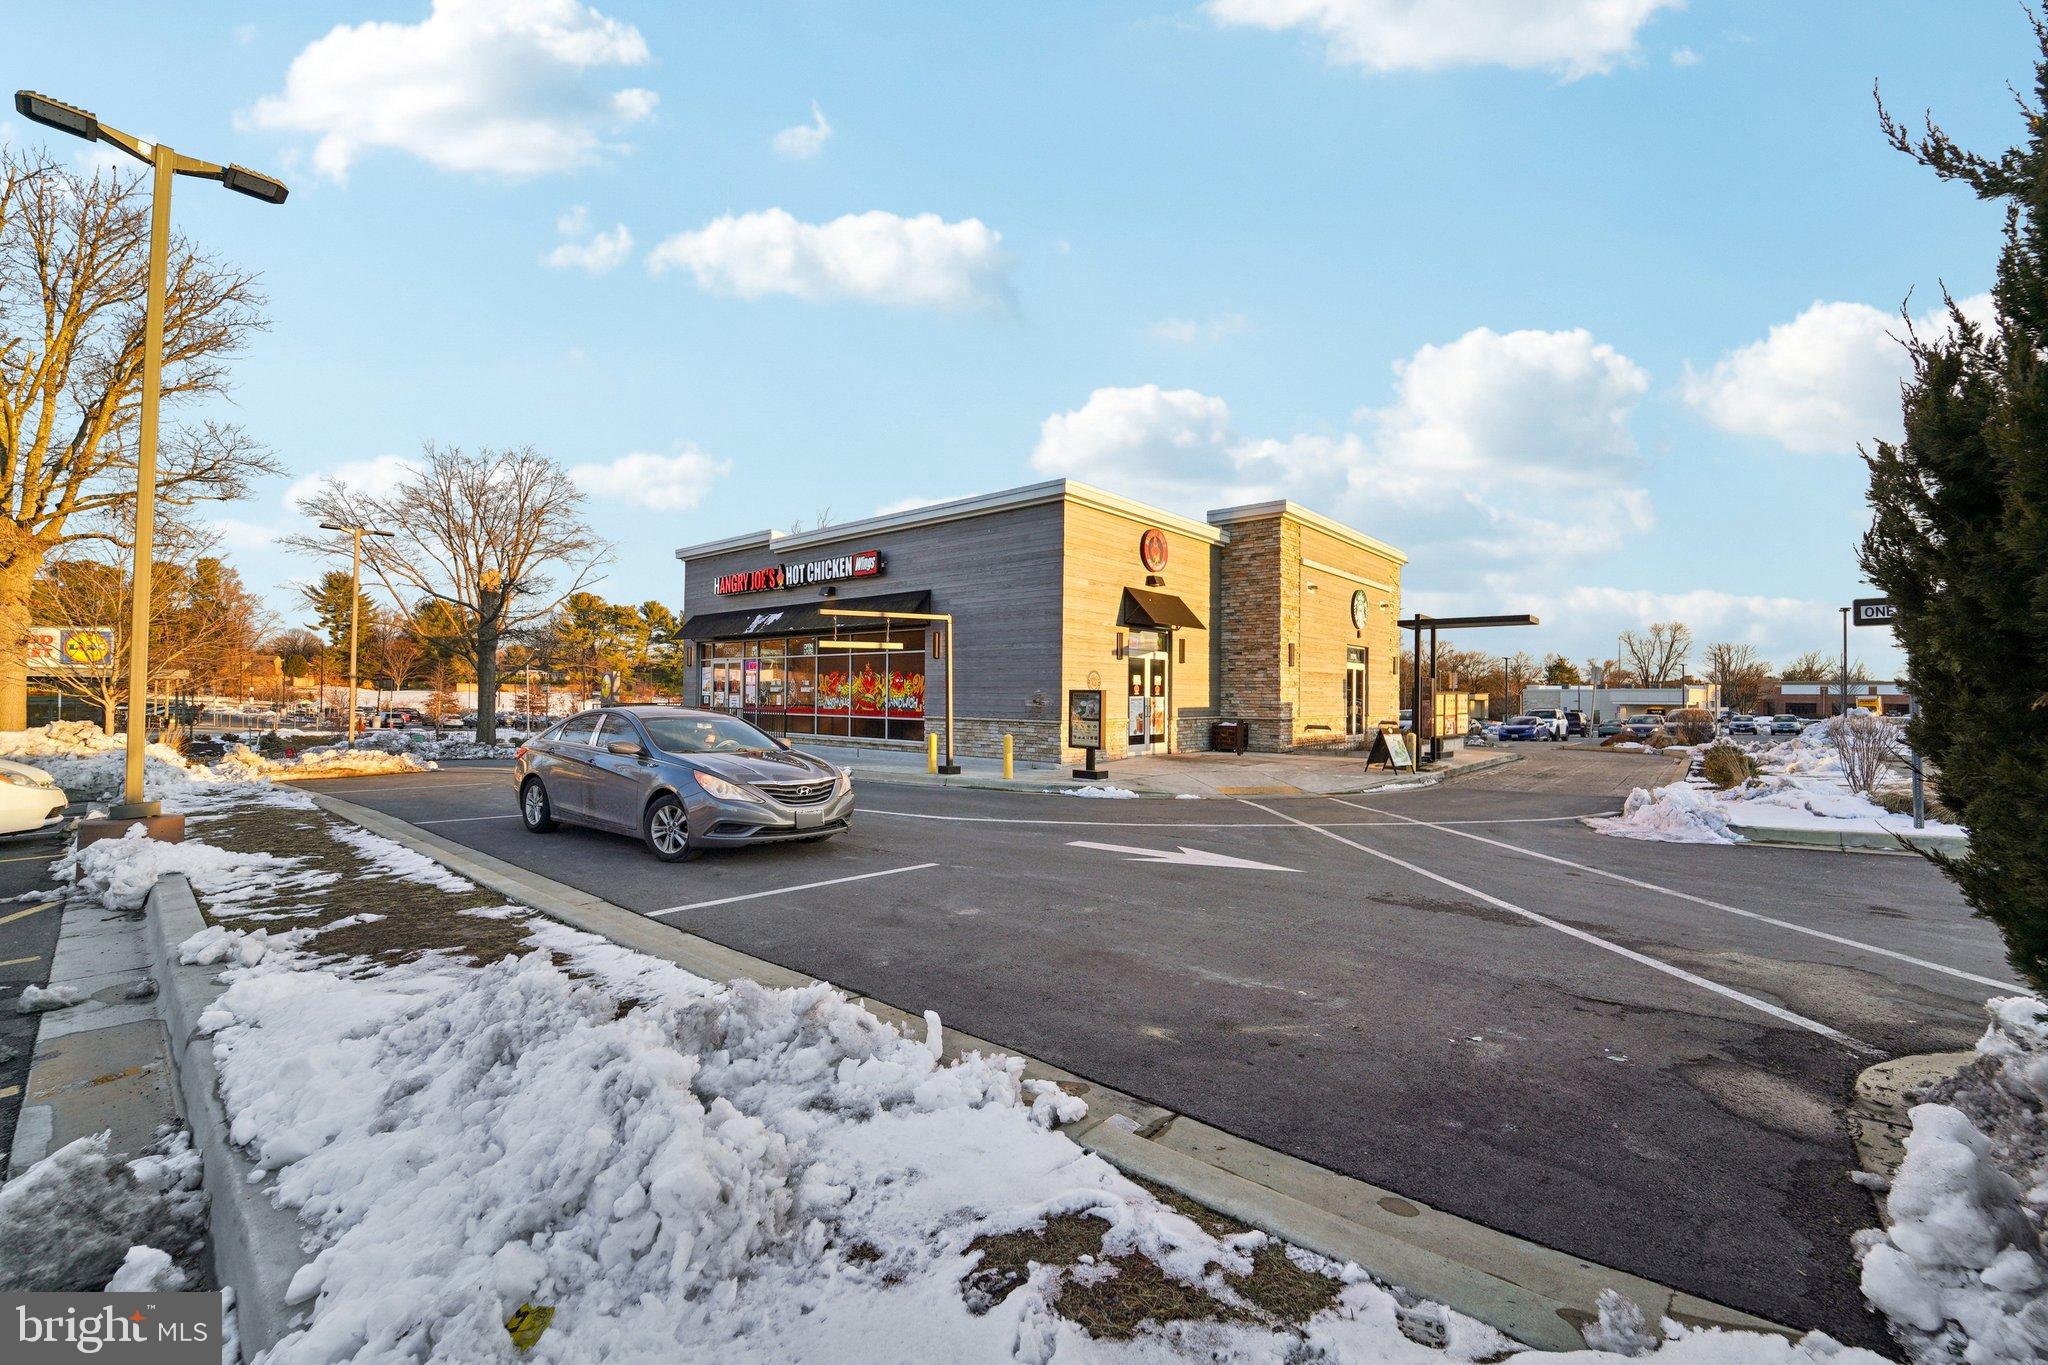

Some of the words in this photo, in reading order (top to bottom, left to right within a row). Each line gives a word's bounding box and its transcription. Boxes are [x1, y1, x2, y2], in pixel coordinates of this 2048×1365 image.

[785, 564, 806, 585] HOT
[806, 556, 853, 582] CHICKEN
[855, 556, 876, 572] Wings
[714, 572, 749, 595] HANGRY
[750, 567, 775, 590] JOE'S
[1864, 605, 1894, 618] ONE
